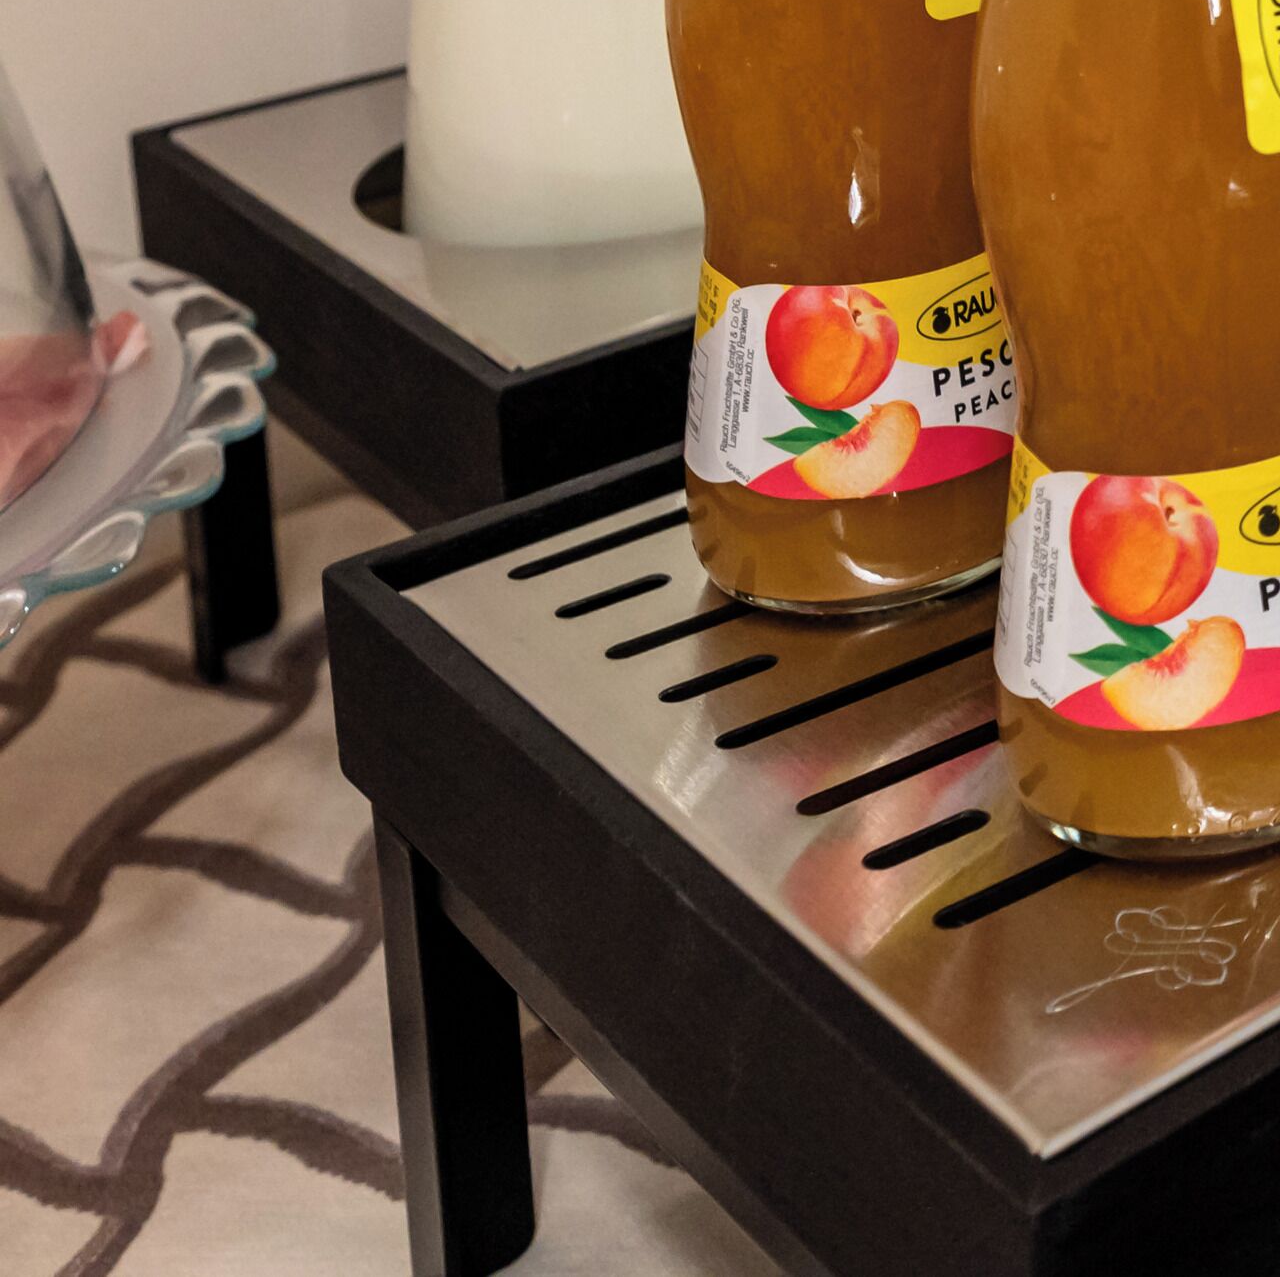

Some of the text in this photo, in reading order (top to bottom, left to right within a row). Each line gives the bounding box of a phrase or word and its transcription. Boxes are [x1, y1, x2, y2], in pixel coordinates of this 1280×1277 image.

[953, 287, 998, 327] RAU
[720, 423, 730, 453] Rauch
[728, 340, 737, 369] GmbH
[729, 399, 741, 449] Langgasse
[735, 348, 745, 388] A-6830
[742, 349, 755, 413] www.rauch.cc
[932, 339, 1013, 397] PESC
[954, 378, 1017, 423] PEAC
